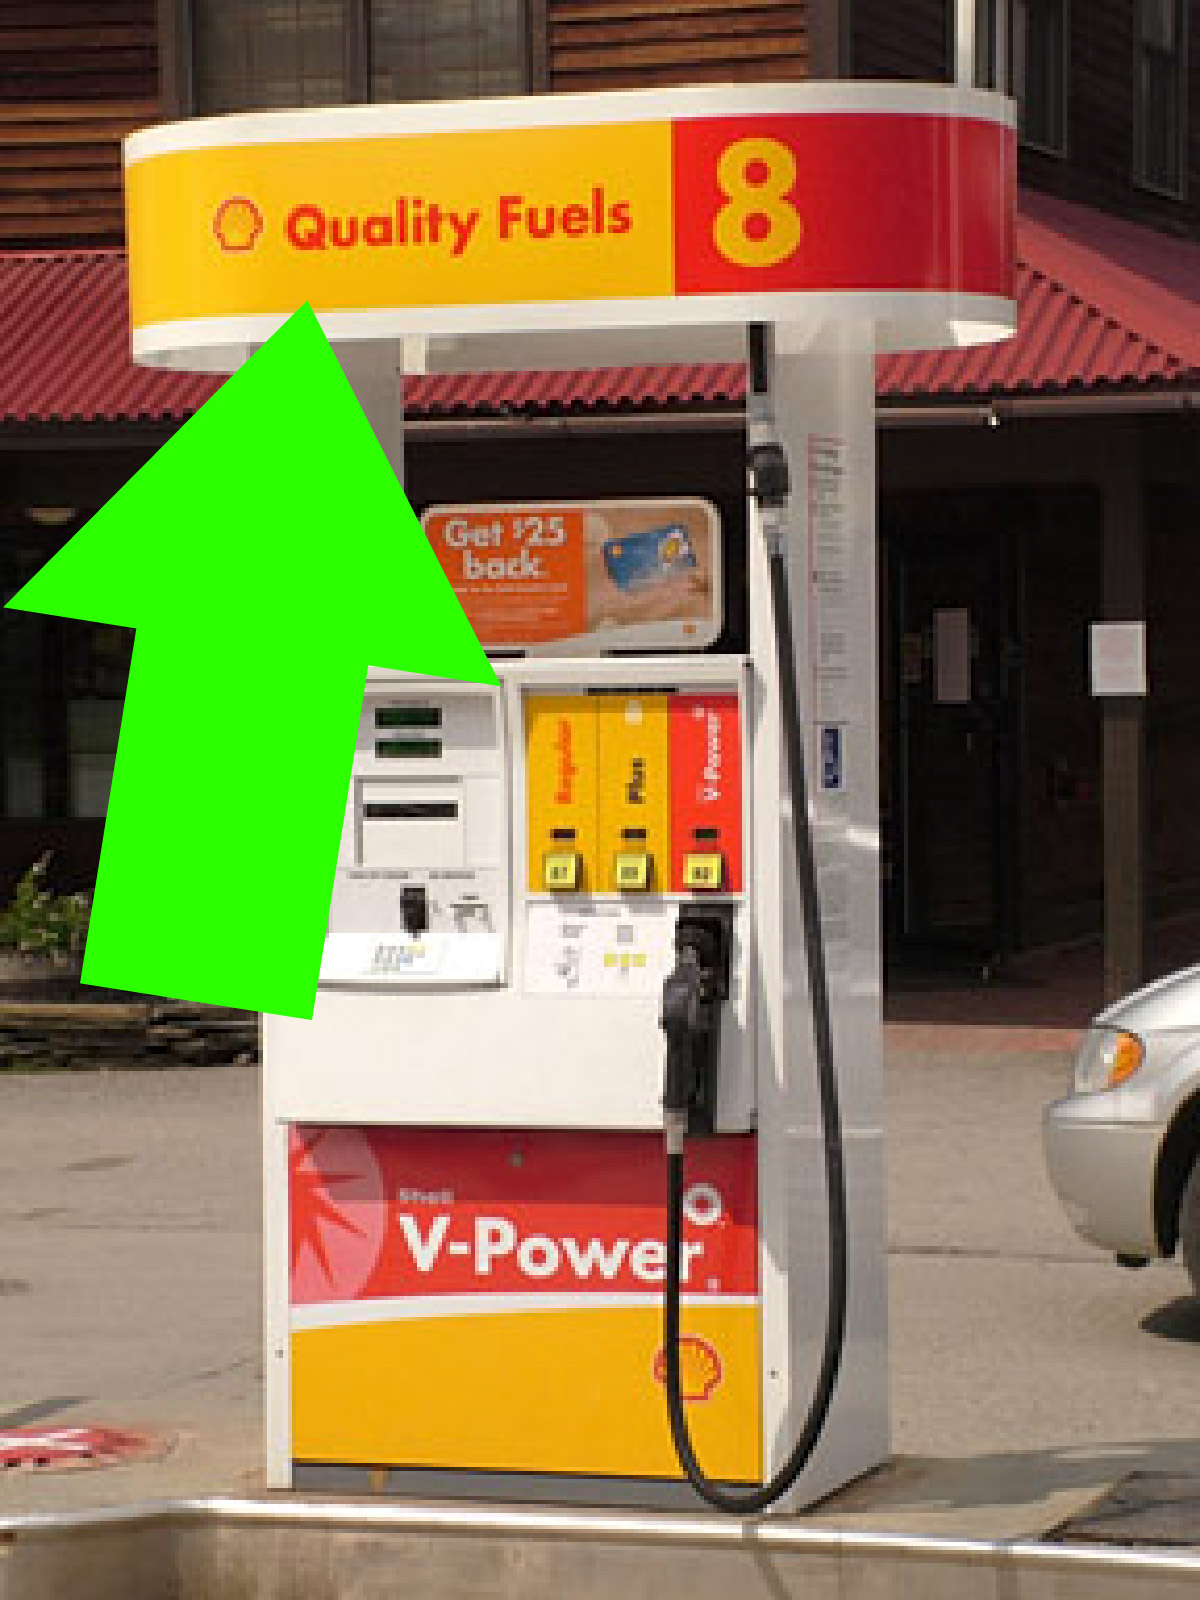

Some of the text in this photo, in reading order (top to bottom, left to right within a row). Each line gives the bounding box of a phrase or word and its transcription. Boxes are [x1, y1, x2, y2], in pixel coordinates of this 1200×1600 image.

[285, 187, 634, 257] Quality Fuels
[713, 137, 803, 267] 8
[444, 519, 505, 548] Get
[462, 548, 546, 580] back
[398, 1213, 706, 1281] V-Power
